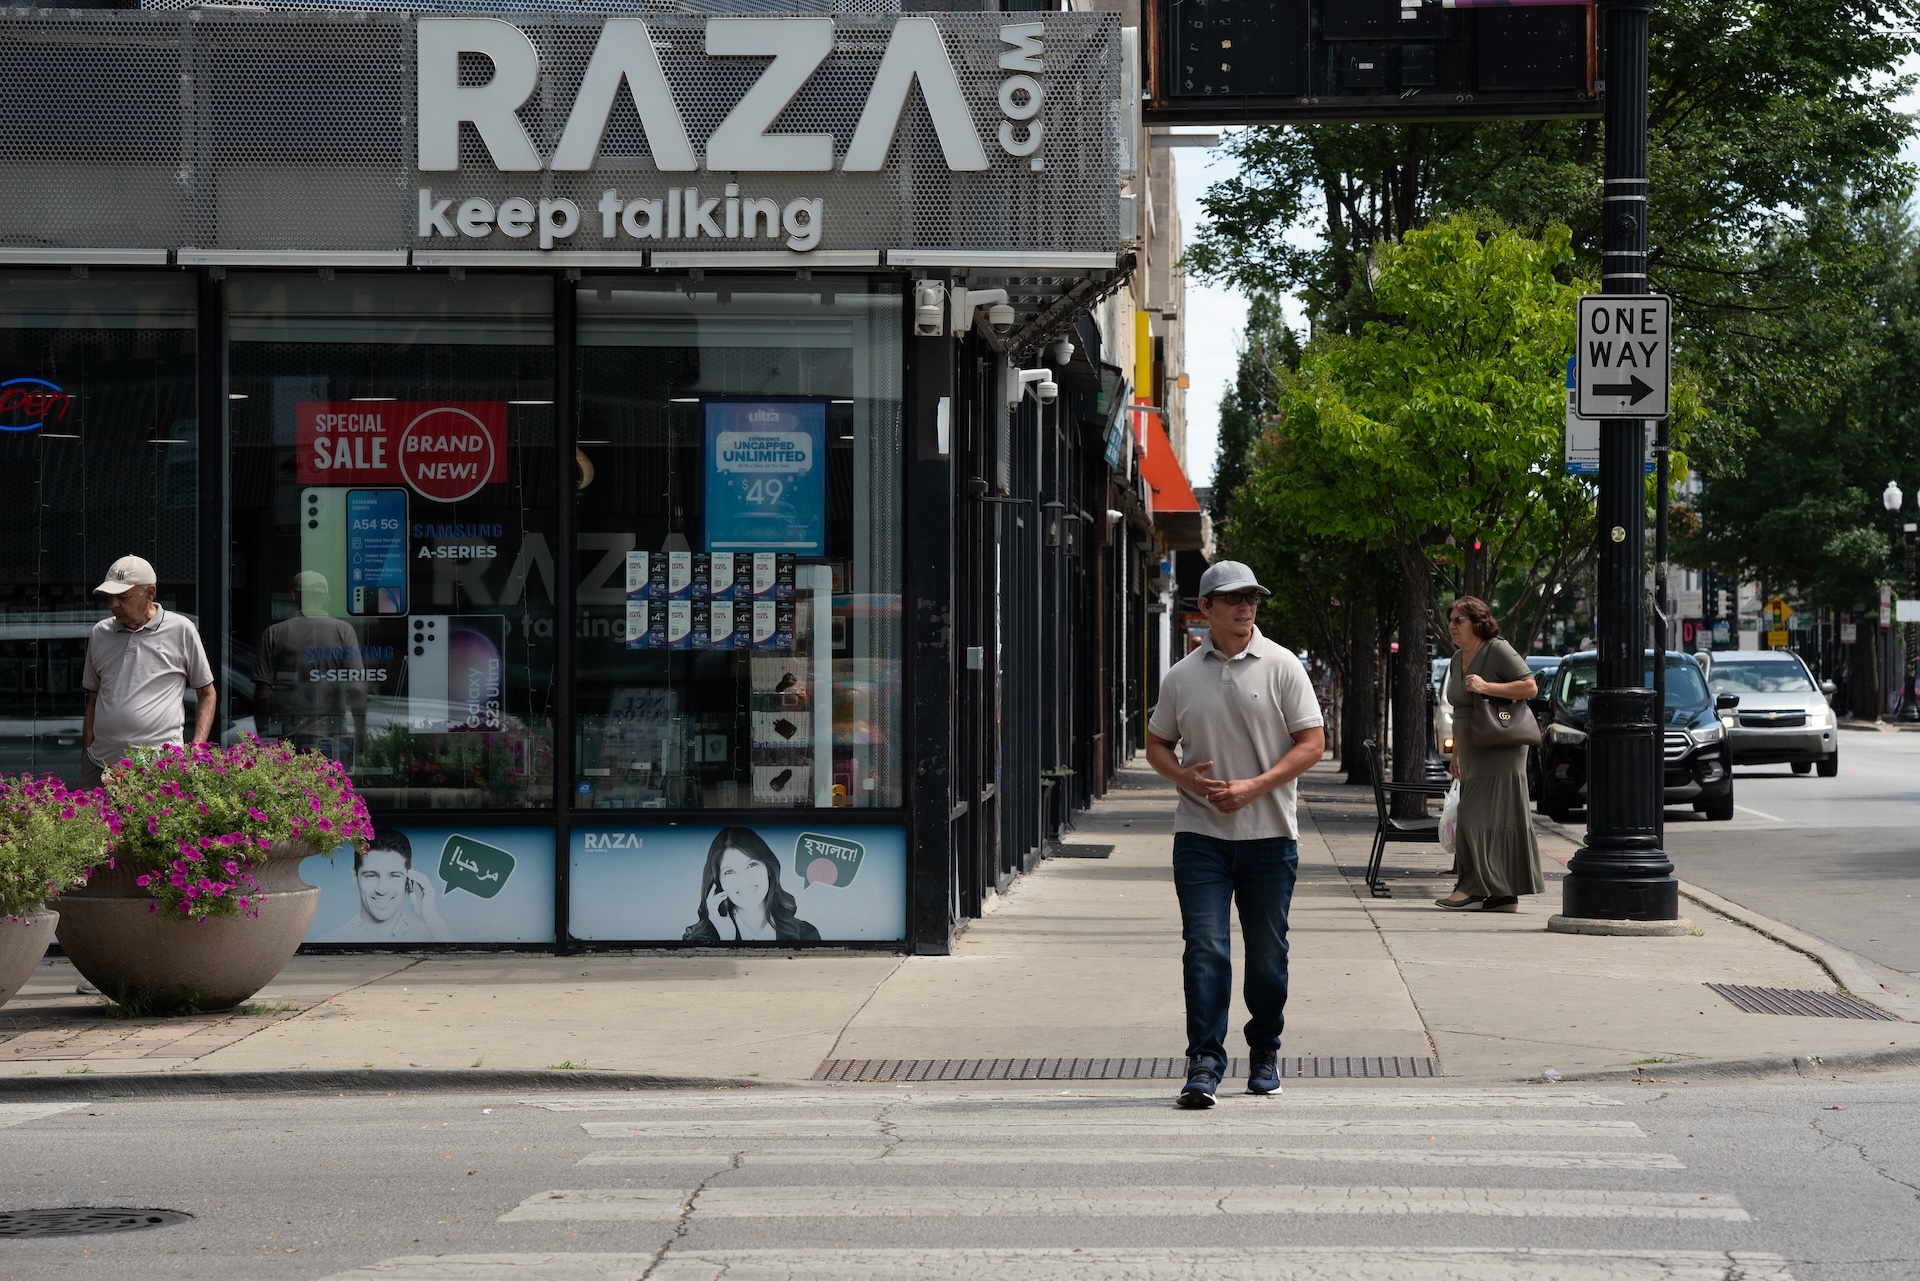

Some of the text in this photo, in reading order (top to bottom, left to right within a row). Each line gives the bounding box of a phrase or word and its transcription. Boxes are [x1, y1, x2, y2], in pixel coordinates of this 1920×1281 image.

[417, 17, 990, 172] RAZA
[418, 183, 823, 252] keep talking
[1591, 307, 1657, 335] ONE
[1589, 341, 1659, 368] WAY
[315, 413, 386, 433] SPECIAL
[406, 435, 484, 452] BRAND
[734, 441, 795, 450] UNCAPPED
[313, 436, 388, 470] SALE
[723, 450, 806, 462] UNLIMITED
[417, 462, 478, 480] NEW!
[742, 478, 784, 505] $49
[352, 518, 399, 530] A54 5G
[412, 523, 503, 538] SAMSUNG
[417, 545, 497, 559] A-SERIES
[303, 645, 394, 661] SAMSUNG
[309, 668, 388, 682] S-SERIES
[466, 667, 483, 729] Galaxy
[485, 658, 500, 729] S23 Ultra
[585, 833, 639, 849] RAZA
